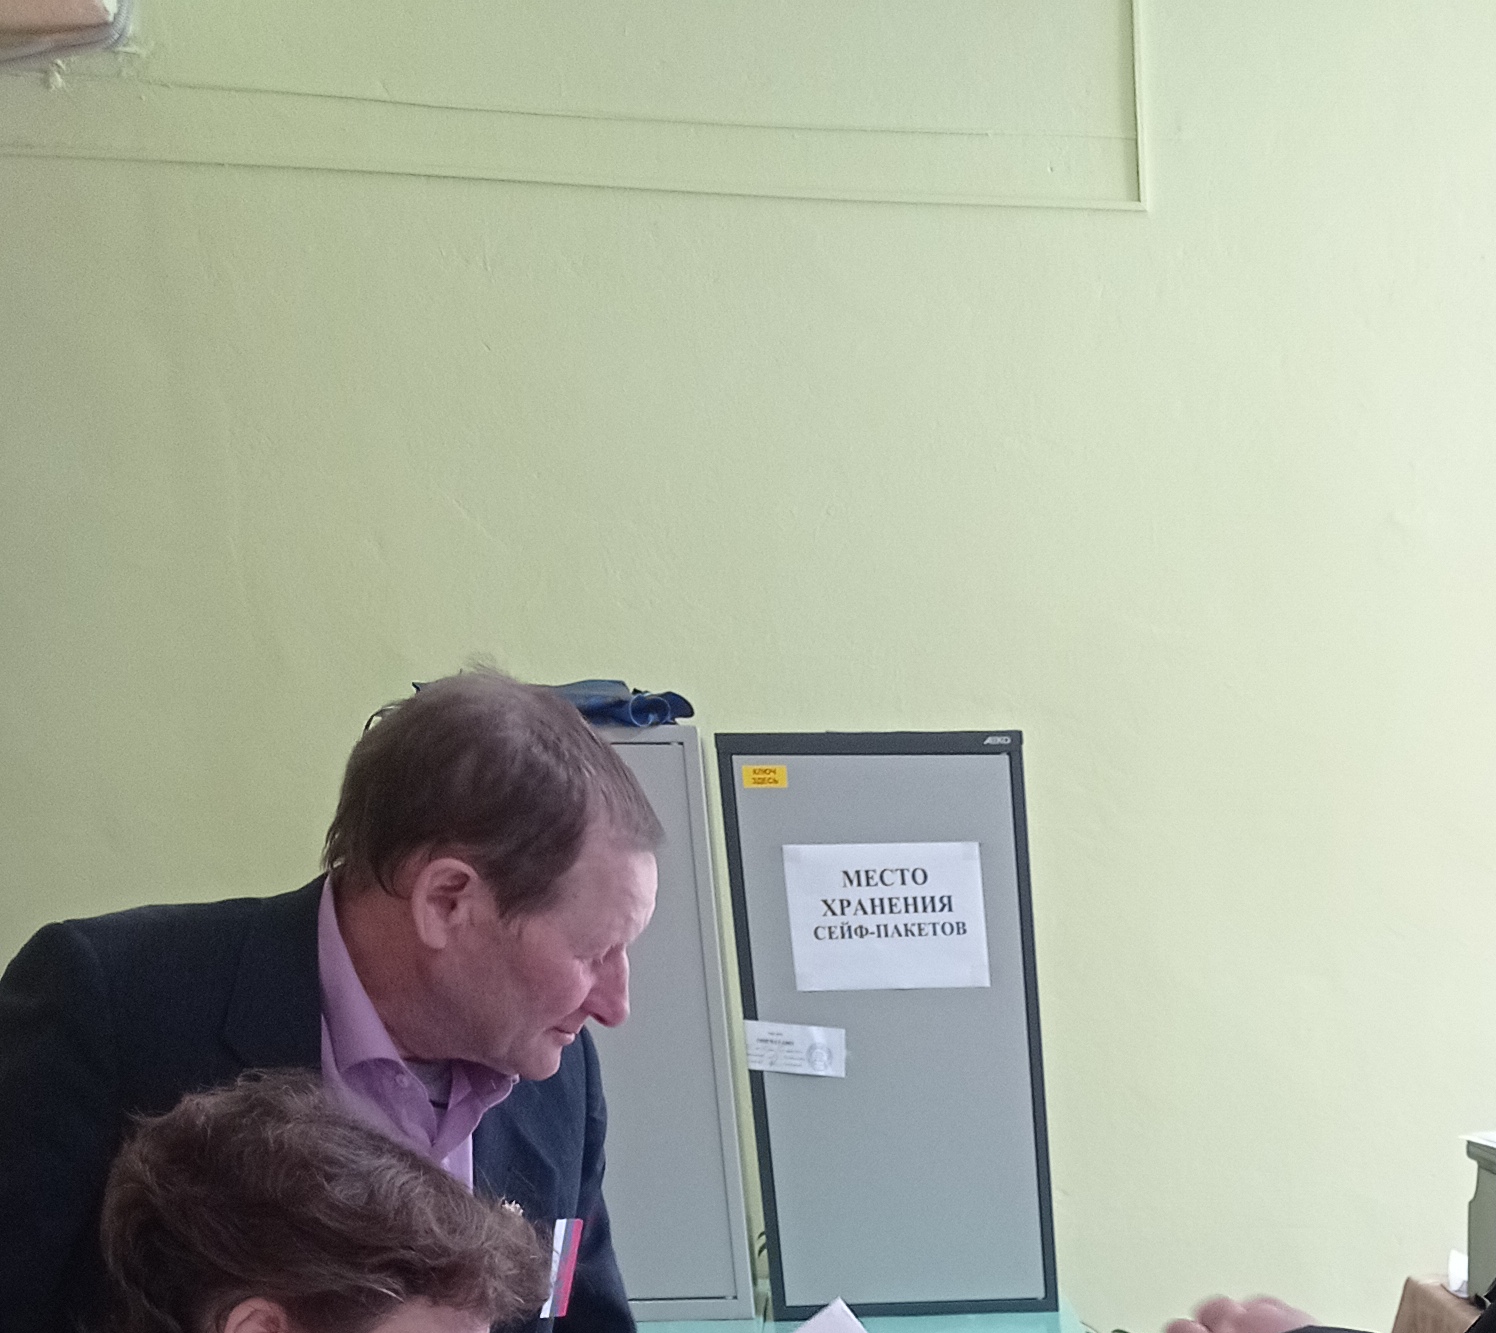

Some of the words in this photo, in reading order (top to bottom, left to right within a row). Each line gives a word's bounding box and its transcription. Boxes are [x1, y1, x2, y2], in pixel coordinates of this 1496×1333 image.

[841, 867, 929, 888] МЕСТО
[820, 895, 954, 918] ХРАНЕНИЯ
[812, 921, 968, 941] СЕЙФ-ПАКЕТОВ
